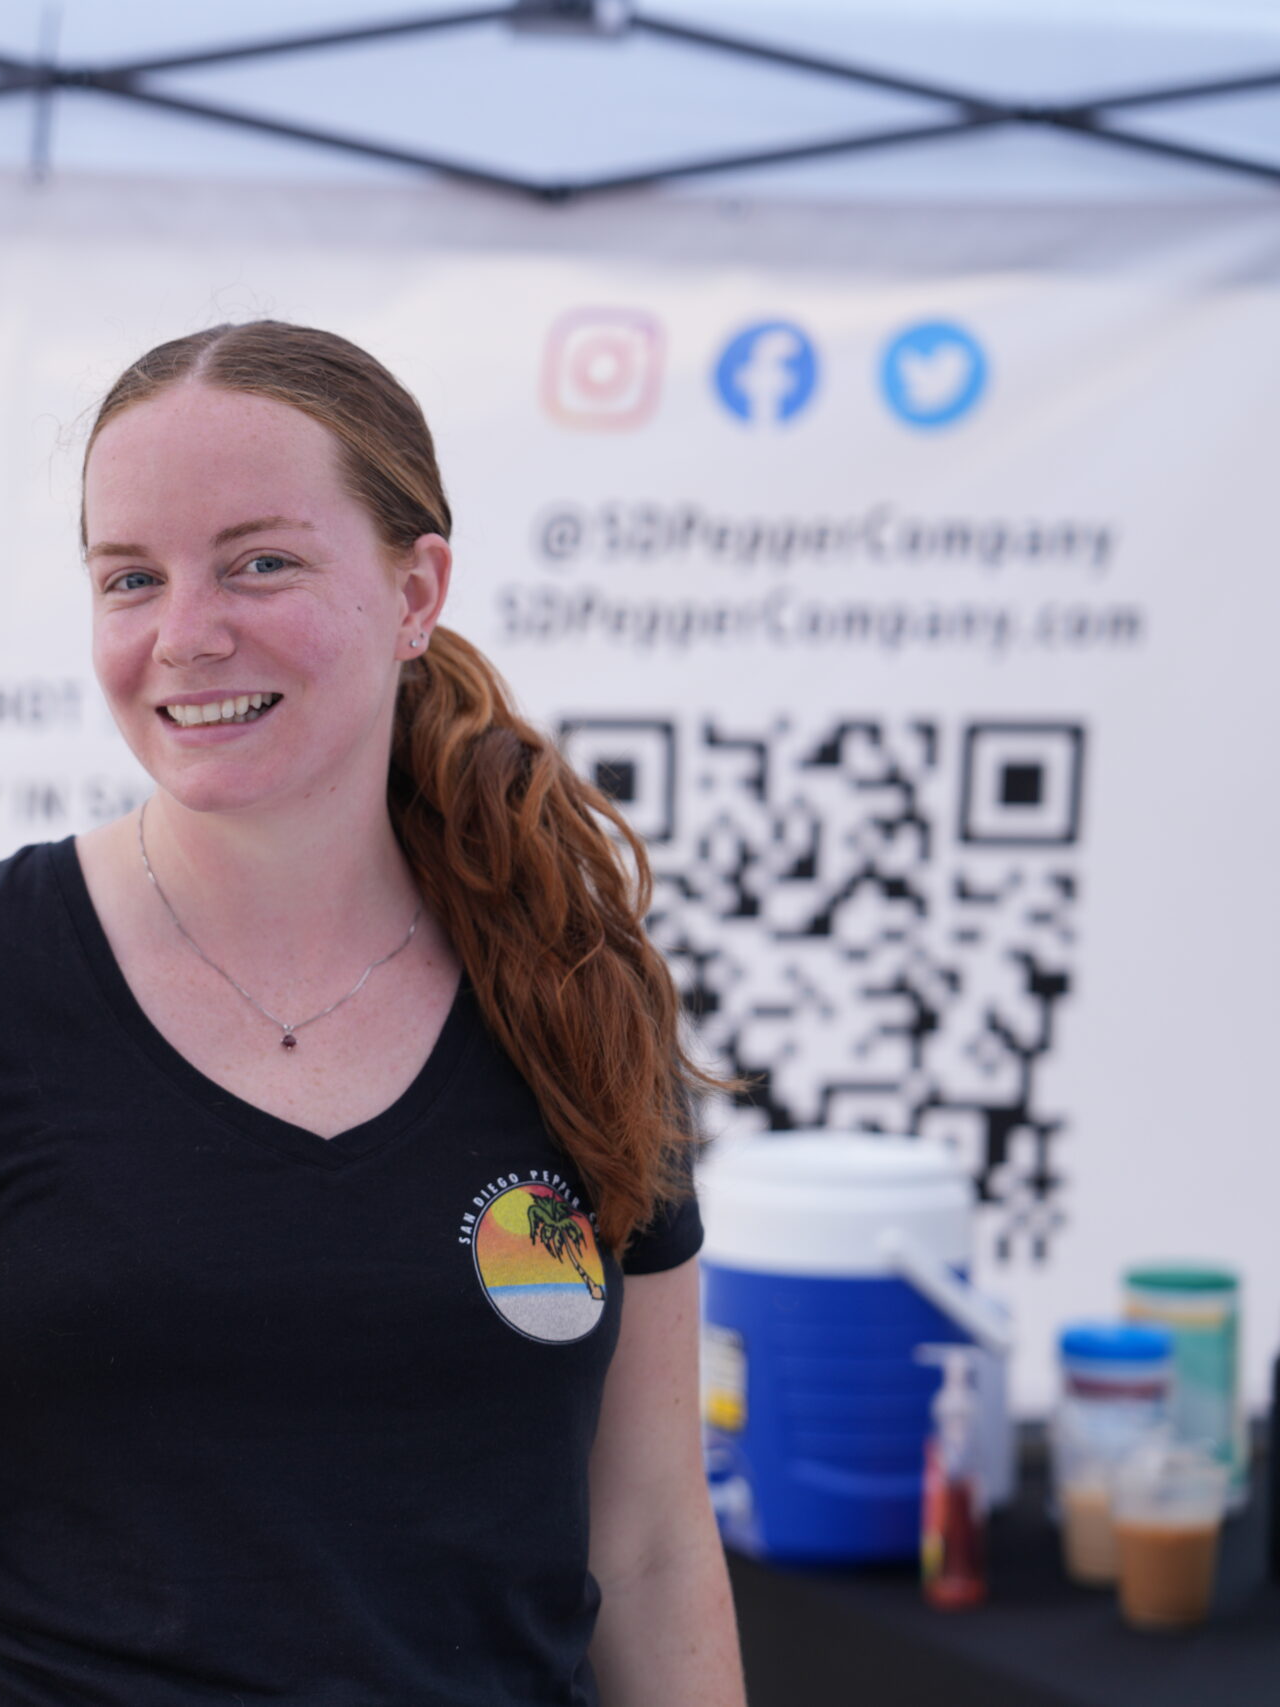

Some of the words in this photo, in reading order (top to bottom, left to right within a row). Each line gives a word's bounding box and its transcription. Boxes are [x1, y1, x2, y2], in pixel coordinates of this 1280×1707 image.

[12, 776, 67, 826] IN
[458, 1212, 477, 1245] SAN
[472, 1172, 520, 1208] DIEGO
[529, 1169, 581, 1209] PEPPER
